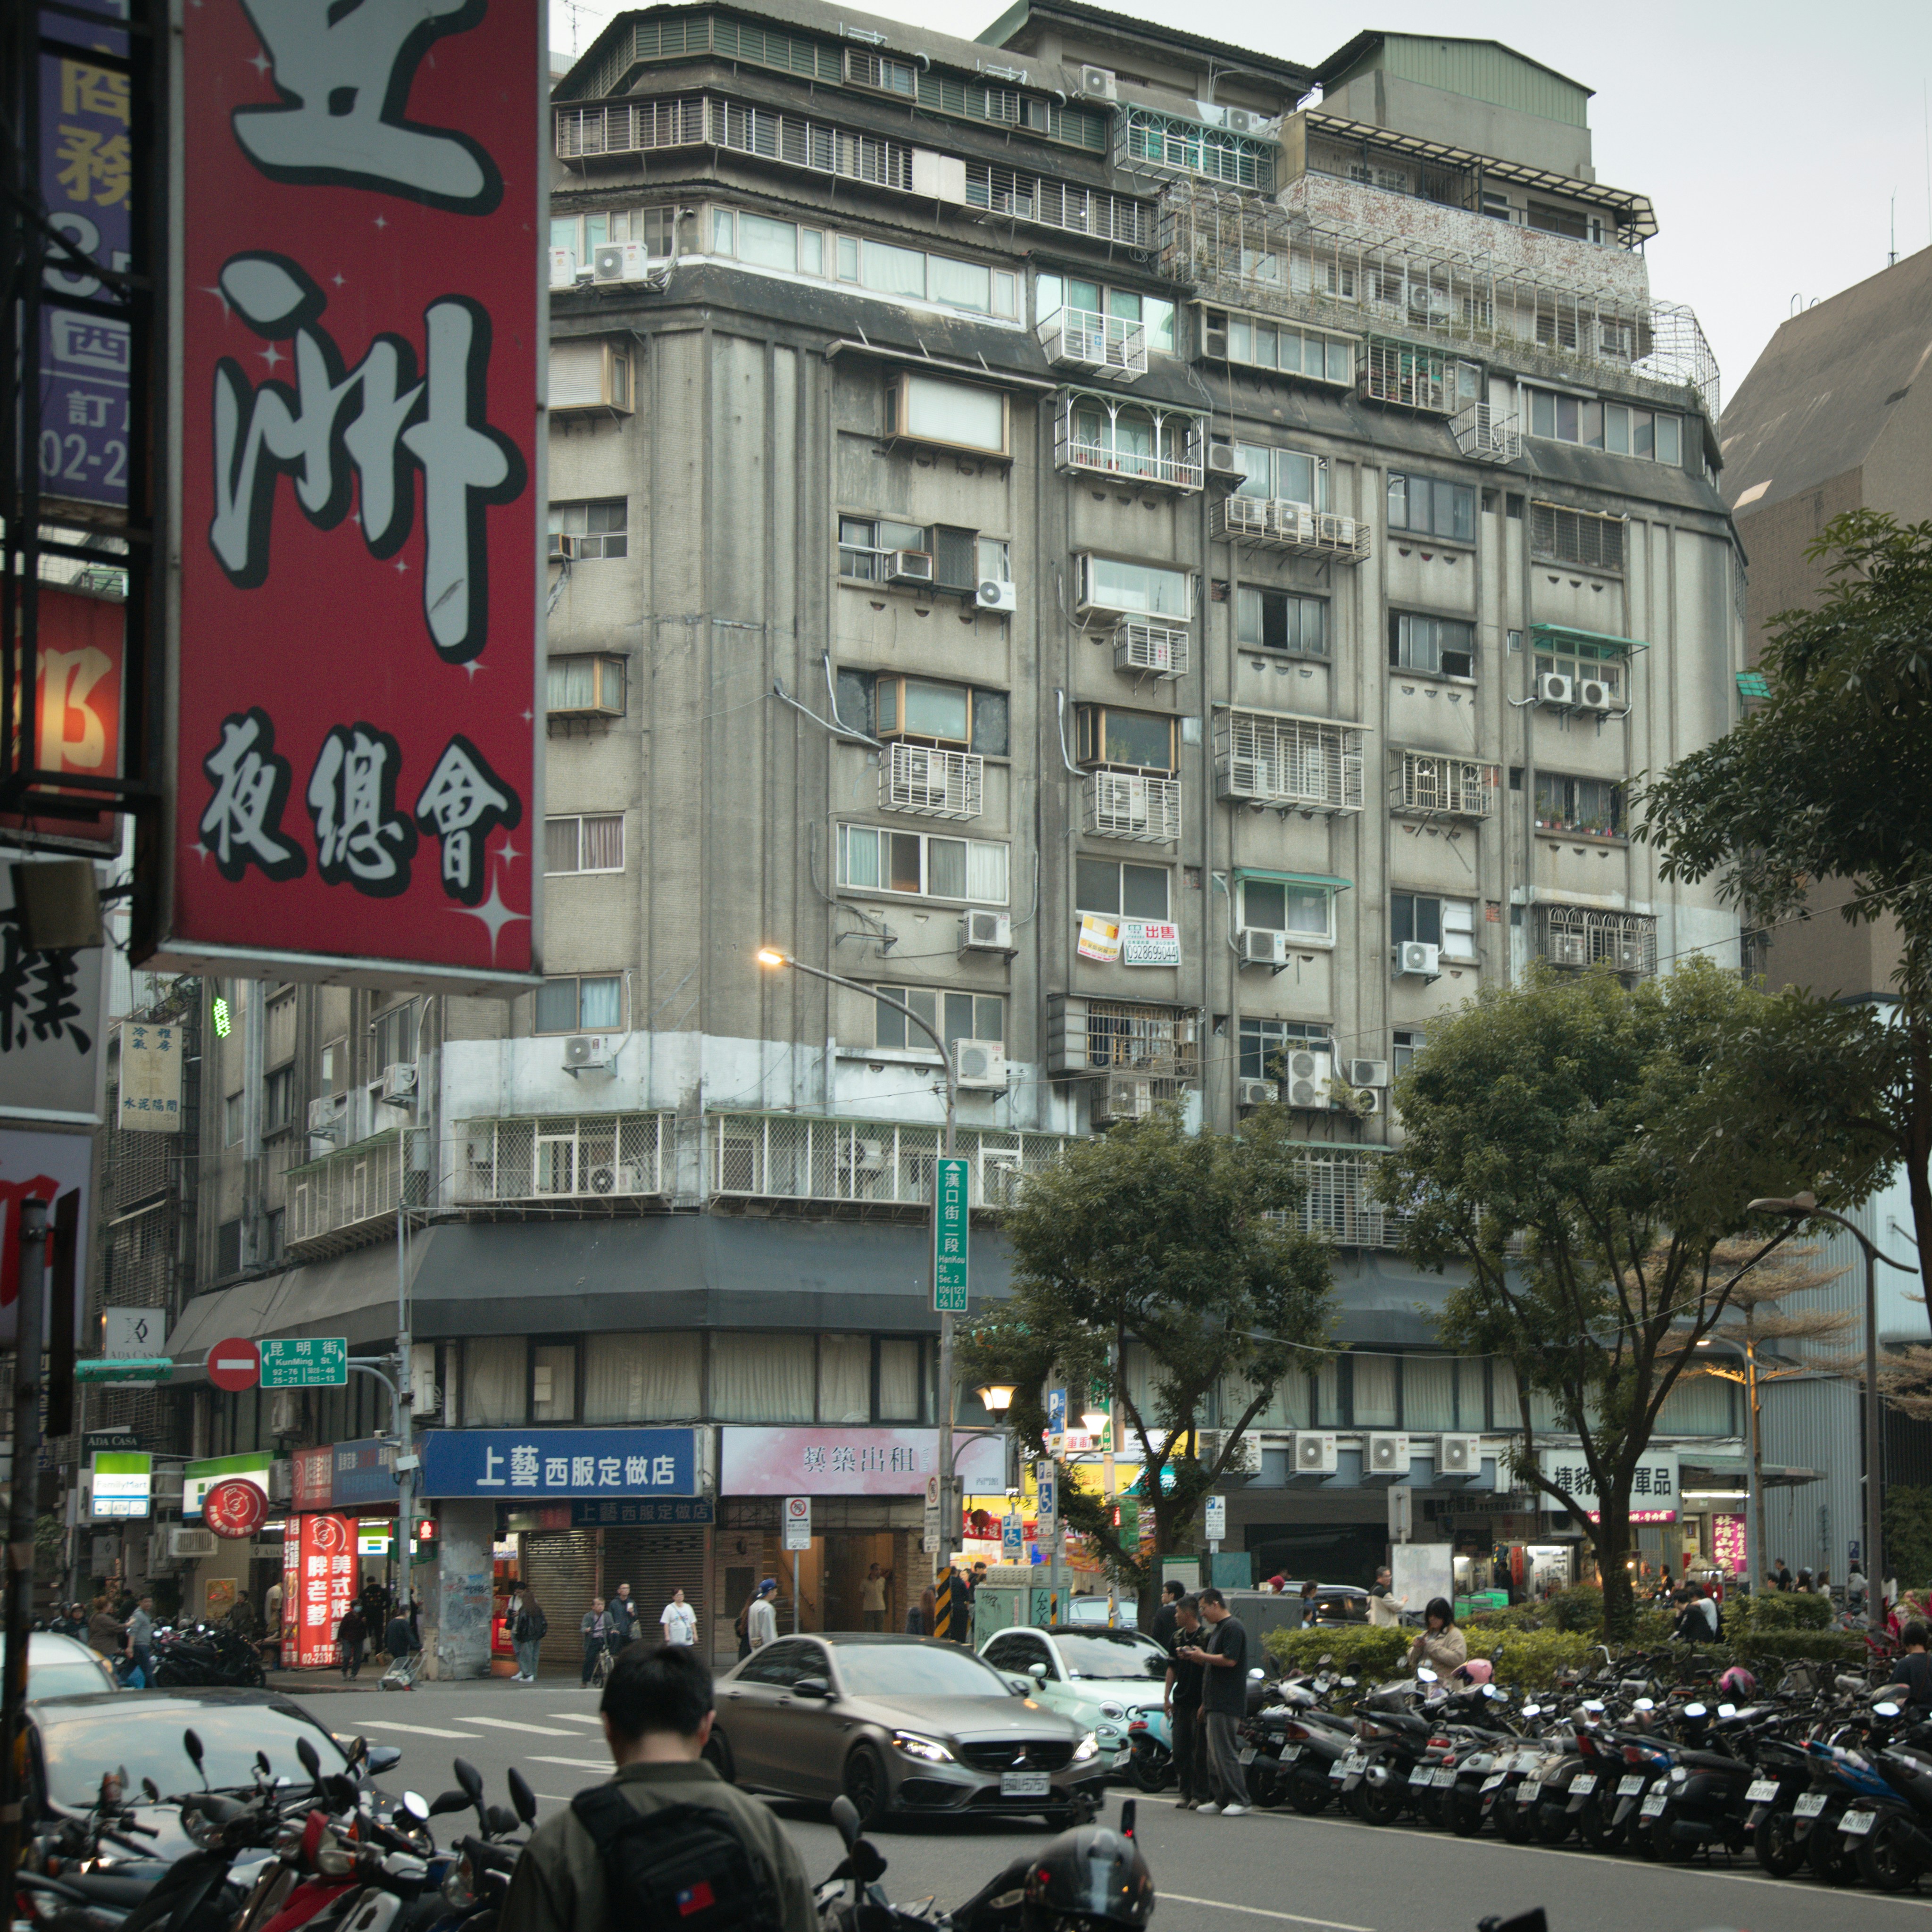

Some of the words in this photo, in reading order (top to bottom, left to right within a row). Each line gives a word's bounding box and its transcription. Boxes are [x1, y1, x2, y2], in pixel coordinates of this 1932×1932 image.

[67, 391, 130, 433] 訂
[1146, 926, 1174, 938] 出售
[124, 1097, 177, 1112] 水泥隔間
[944, 1172, 960, 1253] 漢口街二段
[938, 1255, 966, 1264] HanKou
[954, 1275, 959, 1283] 2
[954, 1286, 965, 1294] 127
[939, 1299, 949, 1307] 56
[955, 1299, 964, 1307] 67
[270, 1341, 338, 1357] 昆明街
[275, 1358, 313, 1366] KunMing
[273, 1376, 297, 1384] 25-21
[87, 1436, 108, 1446] ADA
[111, 1436, 137, 1445] CASA
[476, 1445, 675, 1487] 上藝西服定做店
[96, 1480, 147, 1490] FamilyMart
[1555, 1466, 1672, 1495] 捷豹軍品
[577, 1502, 708, 1522] 上藝西服定做店
[307, 1555, 328, 1626] 胖老爹
